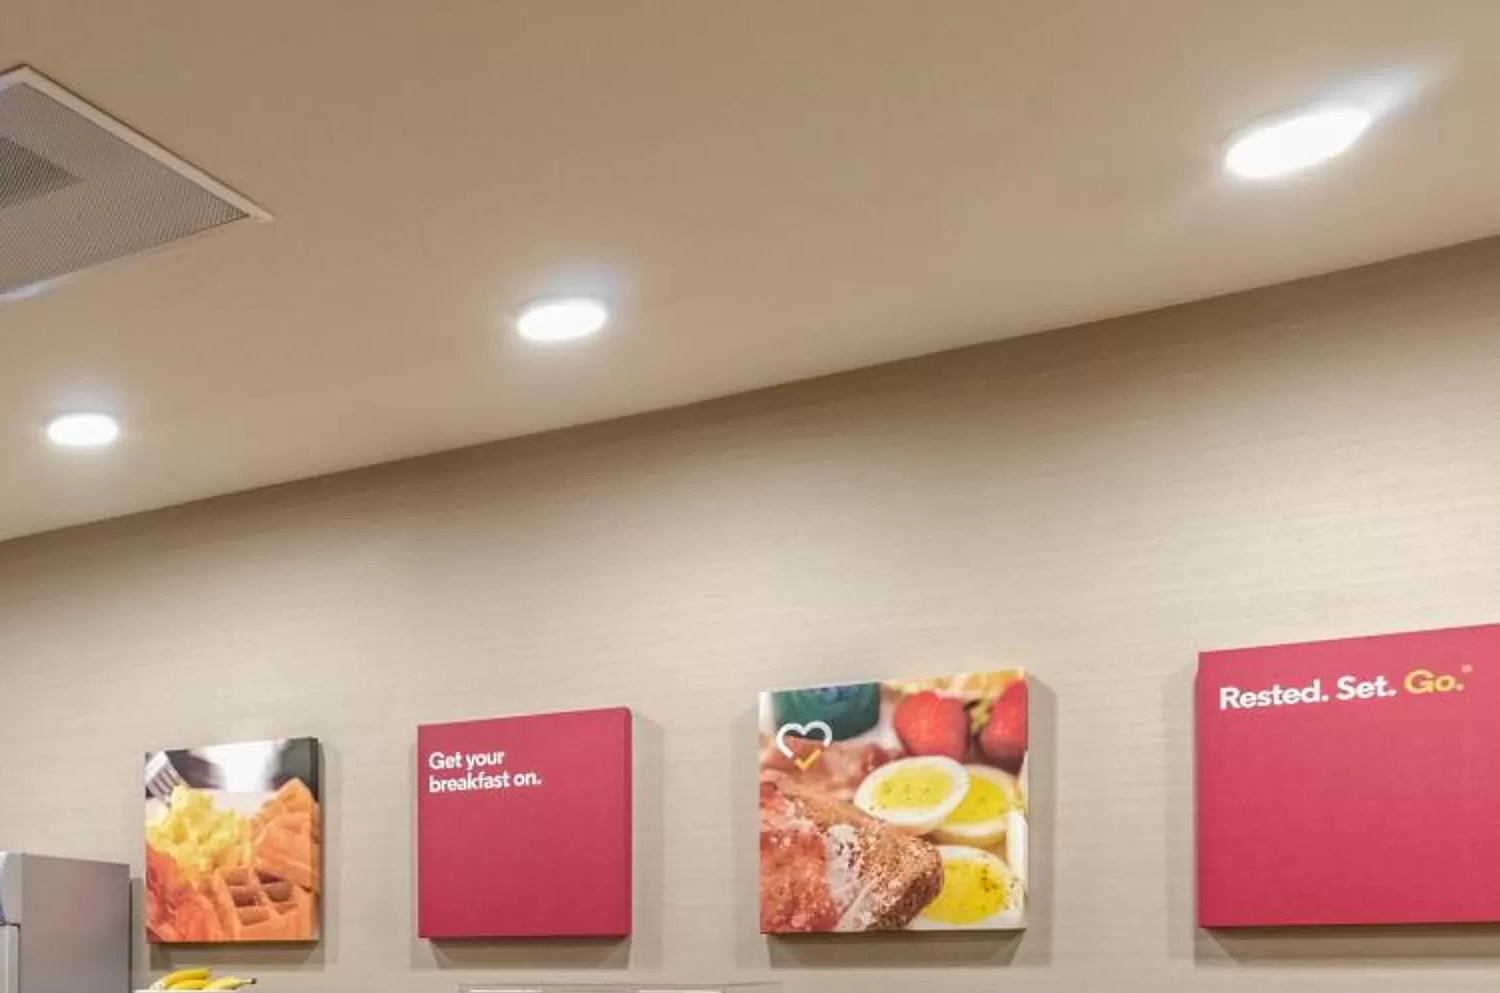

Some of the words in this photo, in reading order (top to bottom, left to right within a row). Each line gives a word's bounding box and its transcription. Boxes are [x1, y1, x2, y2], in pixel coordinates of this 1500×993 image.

[1220, 679, 1329, 710] Rested.
[1336, 675, 1397, 700] Set.
[428, 751, 463, 770] Get
[465, 751, 505, 771] your
[429, 769, 511, 793] breakfast
[513, 771, 543, 787] on.
